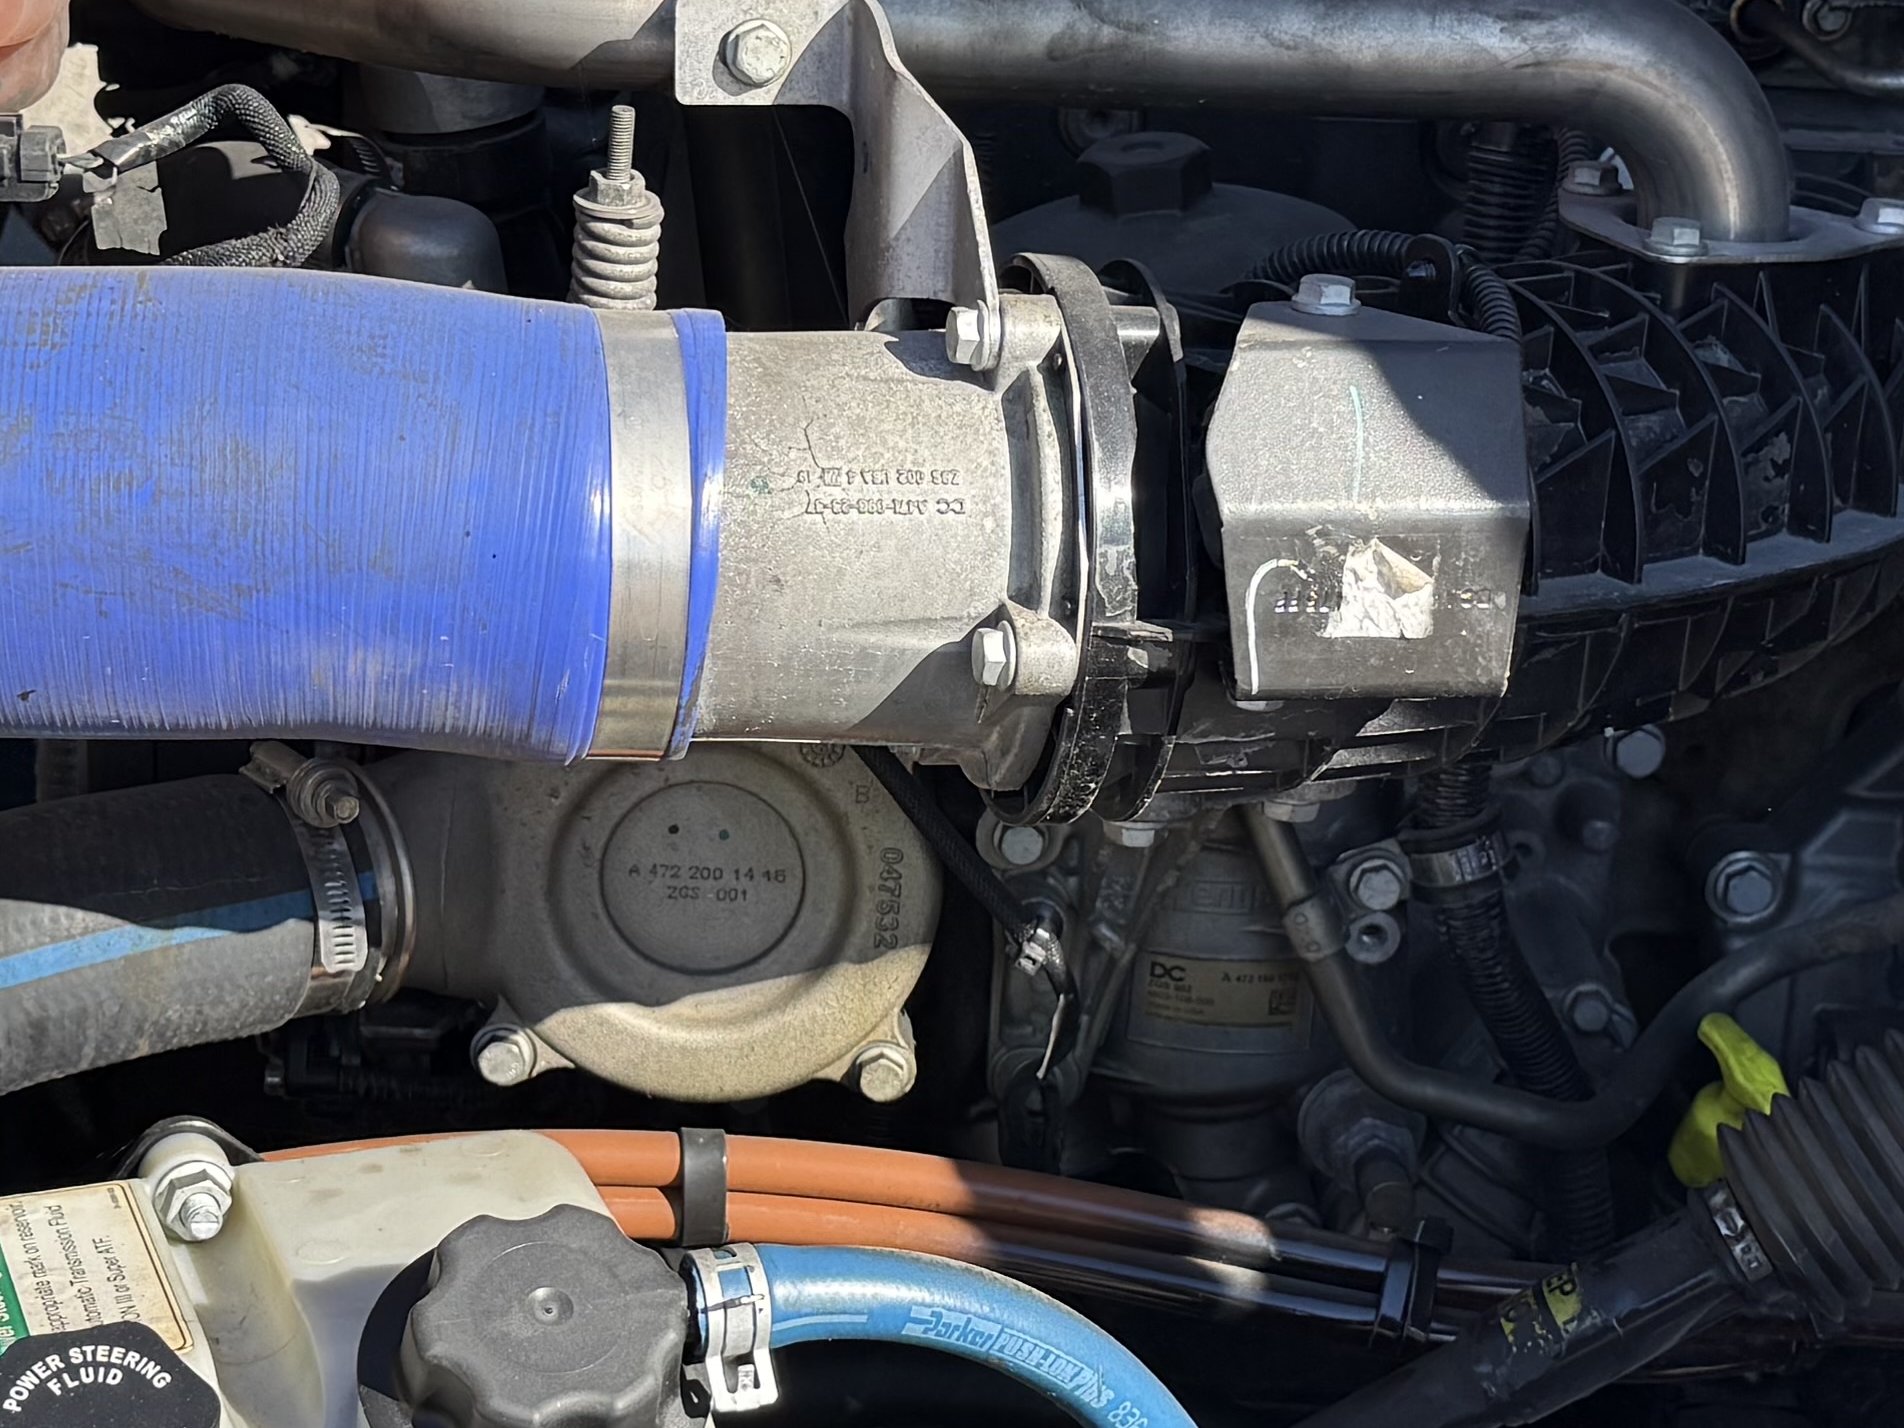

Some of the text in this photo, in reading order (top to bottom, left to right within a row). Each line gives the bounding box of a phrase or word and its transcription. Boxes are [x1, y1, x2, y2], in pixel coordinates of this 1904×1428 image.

[628, 863, 640, 878] A
[649, 864, 682, 881] 472
[689, 865, 723, 881] 200
[715, 887, 748, 902] 001
[1149, 960, 1187, 982] DC
[4, 1198, 35, 1244] reservoir.
[23, 1240, 39, 1255] on
[43, 1201, 90, 1287] Transmission Fluid
[22, 1253, 48, 1280] mark
[100, 1253, 127, 1284] Super
[112, 1281, 129, 1294] or
[925, 1308, 998, 1350] Parker
[2, 1345, 173, 1414] POWER STEERING
[47, 1367, 124, 1397] FLUID
